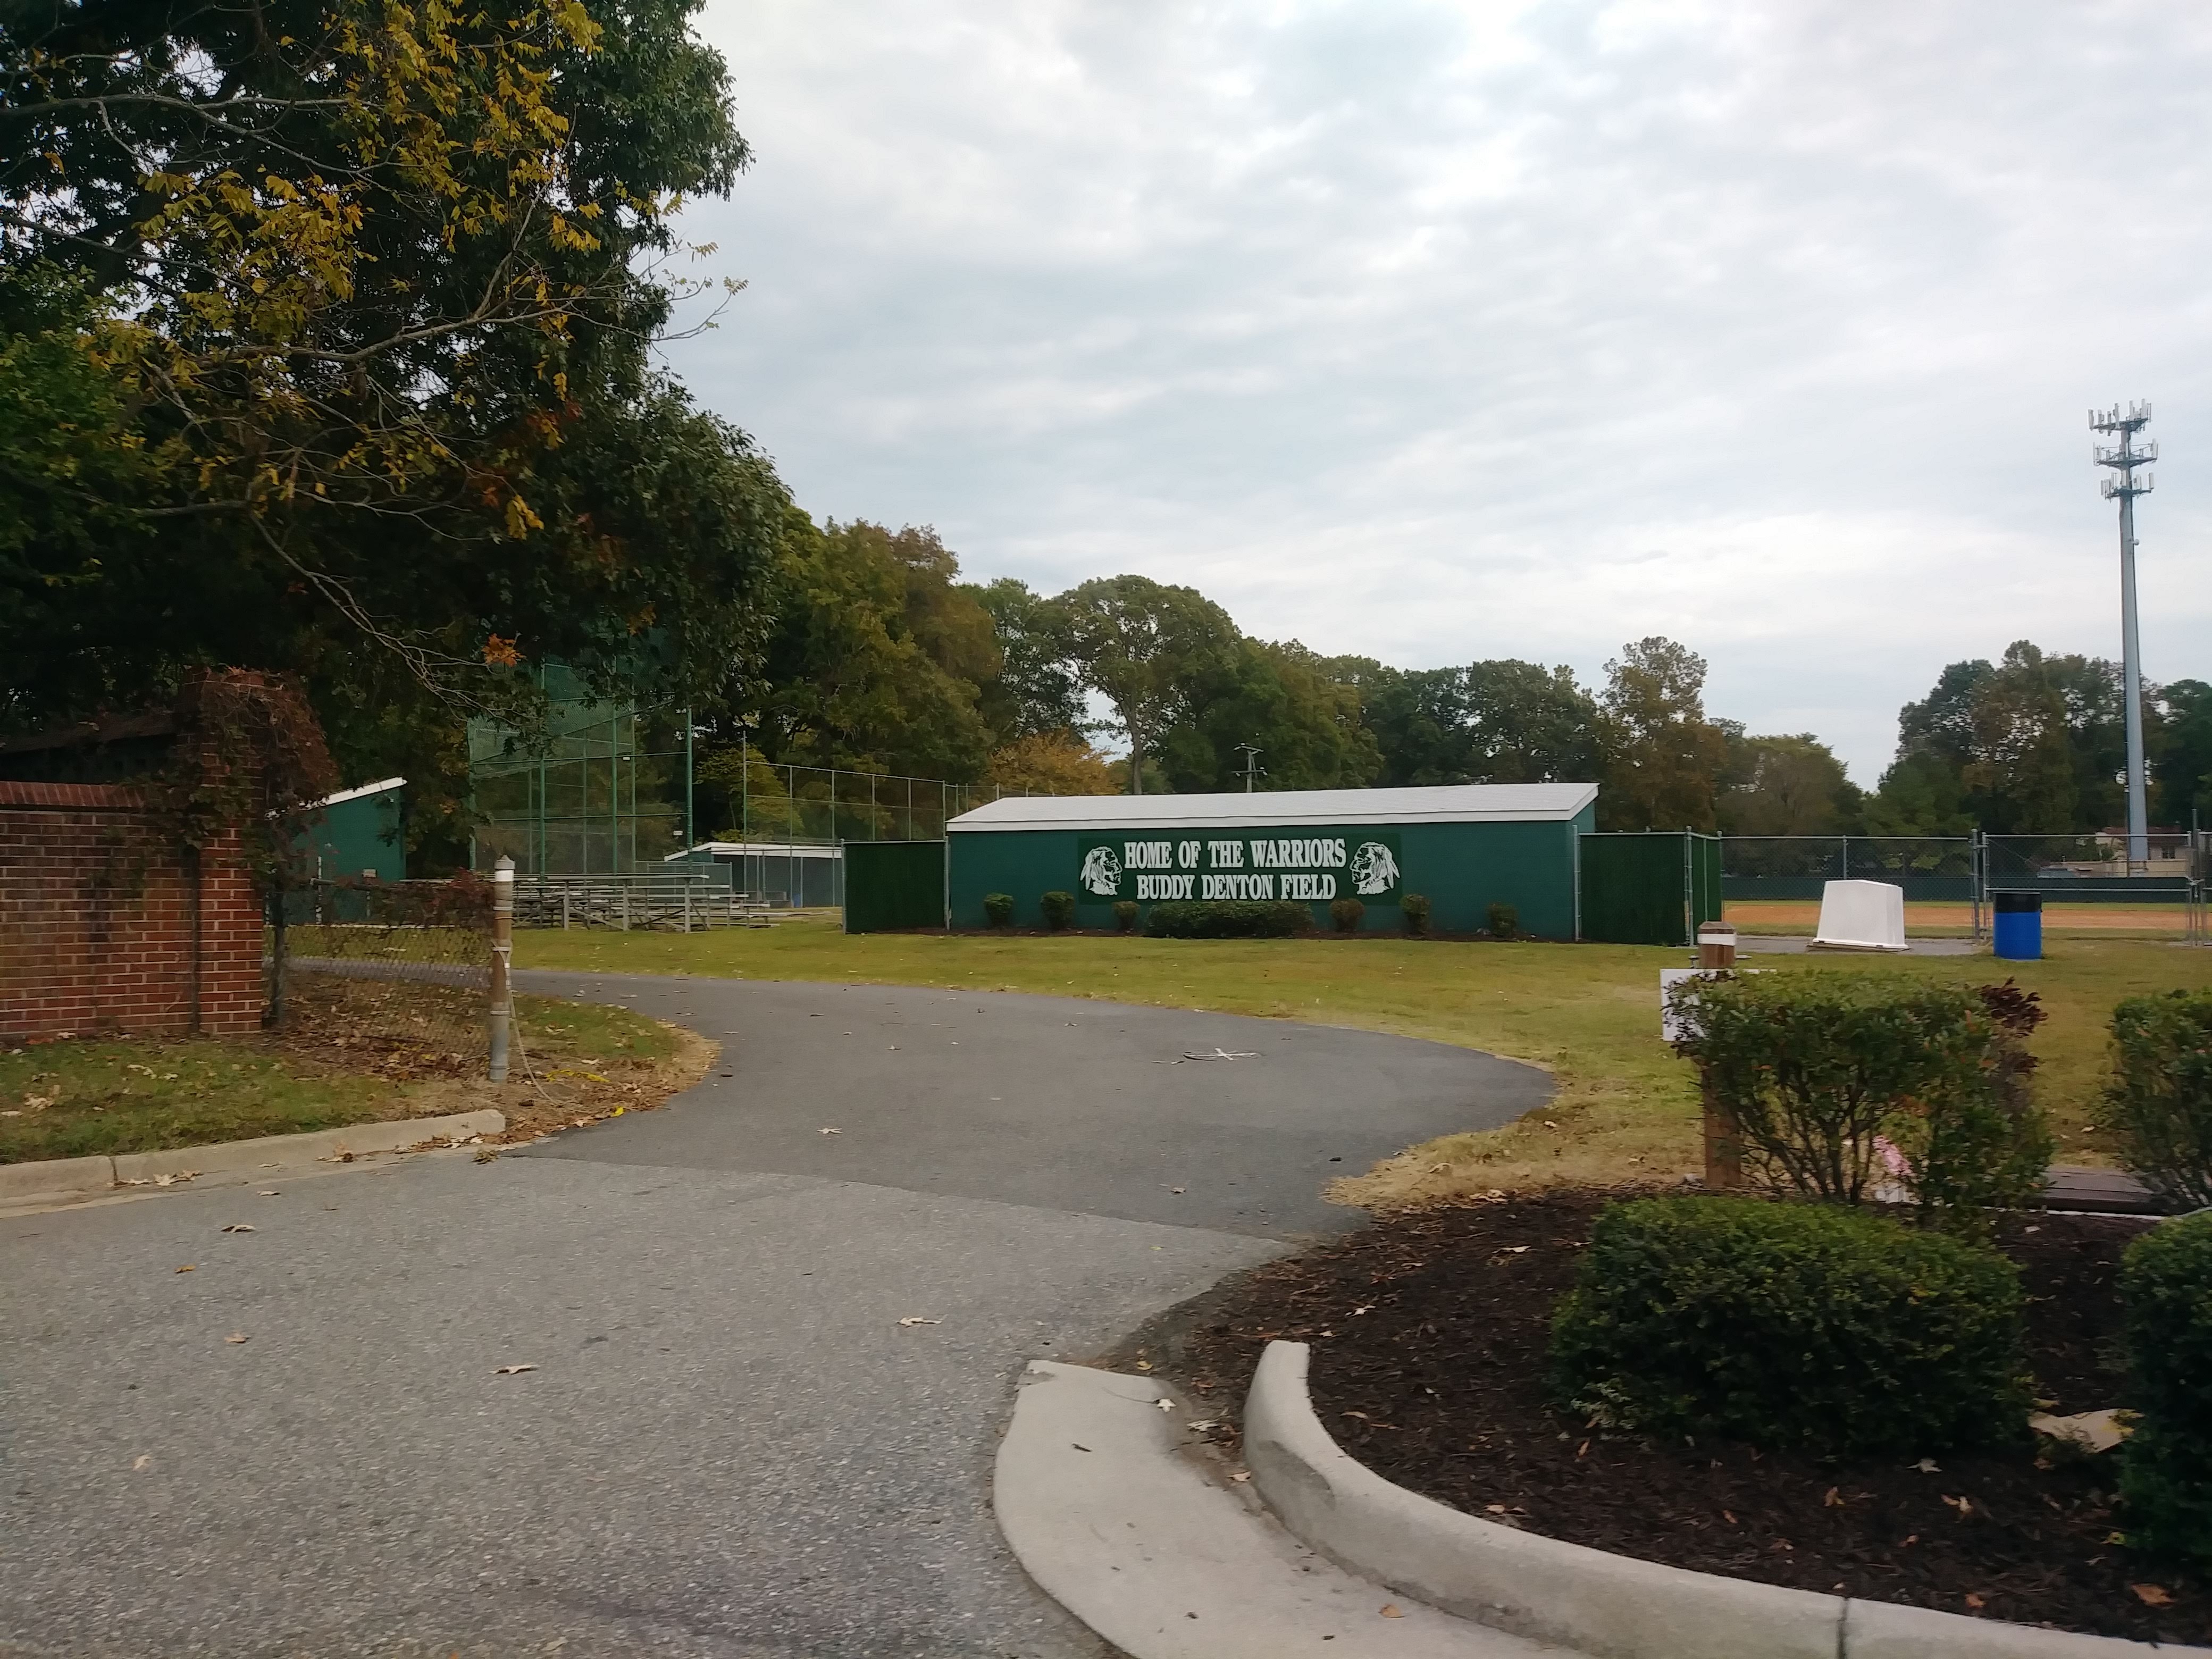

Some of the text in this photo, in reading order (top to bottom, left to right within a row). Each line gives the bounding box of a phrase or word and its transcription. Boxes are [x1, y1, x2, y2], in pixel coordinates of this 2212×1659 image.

[1124, 838, 1346, 869] HOME OF THE WARRIORS
[1136, 874, 1337, 900] BUDDY DENTON FIELD
